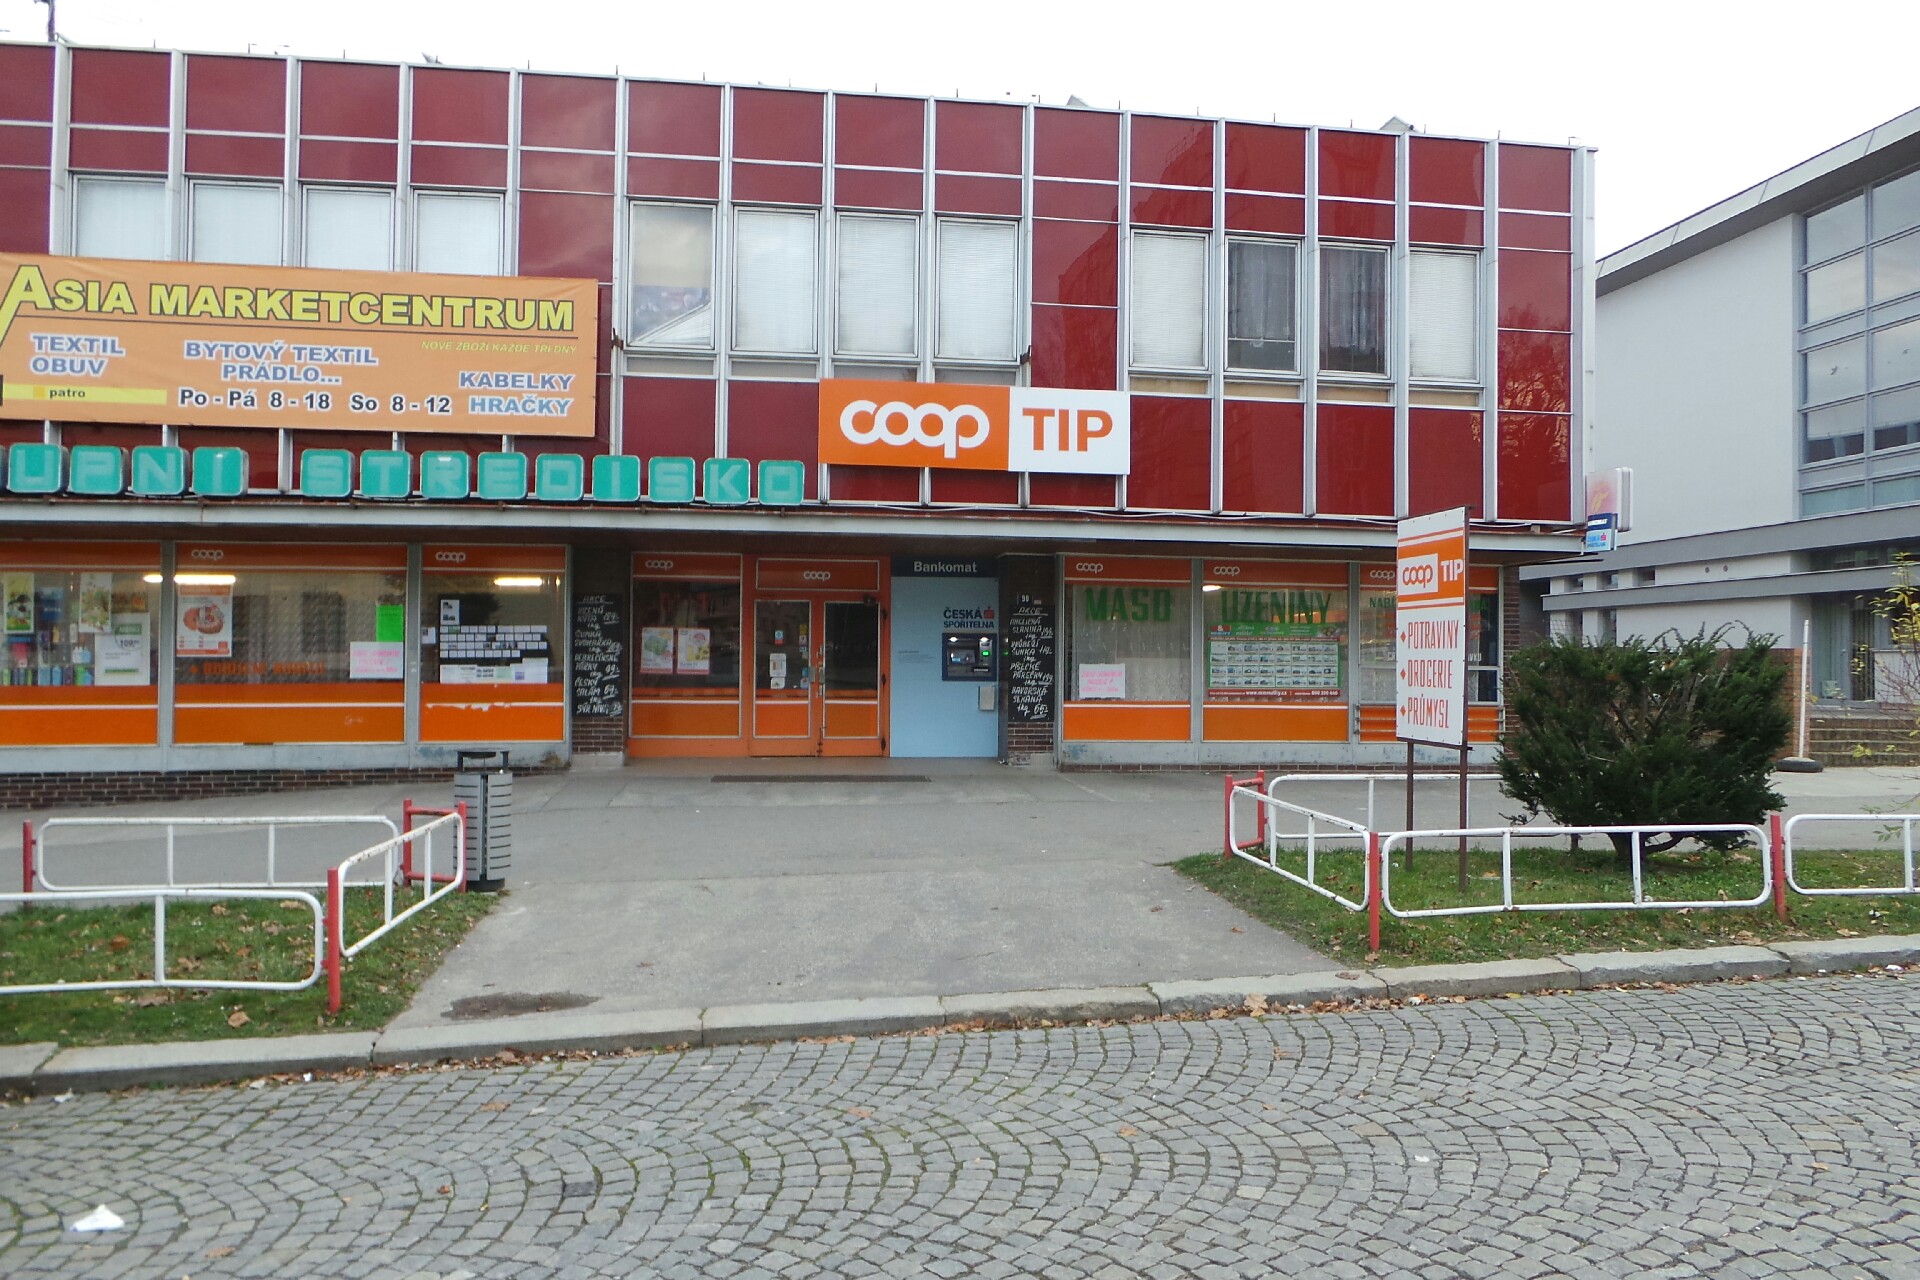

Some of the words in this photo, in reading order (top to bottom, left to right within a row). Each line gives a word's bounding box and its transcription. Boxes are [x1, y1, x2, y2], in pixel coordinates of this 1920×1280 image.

[0, 265, 137, 335] ASIA
[150, 284, 574, 331] MARKETCENTRUM
[31, 333, 125, 356] TEXTIL
[184, 340, 287, 362] BYTOVÝ
[292, 345, 378, 364] TEXTIL
[31, 356, 107, 376] OBUV
[222, 361, 341, 384] PRÁDLO...
[459, 371, 575, 391] KABELKY
[49, 389, 86, 399] patro
[179, 388, 208, 407] Po
[228, 388, 257, 409] Pá
[269, 391, 282, 409] 8
[304, 393, 331, 410] 18
[350, 393, 378, 411] So
[391, 395, 405, 413] 8
[426, 396, 451, 413] 12
[470, 394, 572, 415] HRAČKY
[839, 399, 990, 459] coop
[1022, 407, 1113, 452] TIP
[191, 550, 223, 560] coop
[436, 552, 466, 563] coop
[645, 559, 673, 570] coop
[803, 571, 831, 581] coop
[913, 561, 978, 573] Bankomat
[1076, 562, 1103, 573] coop
[1213, 566, 1240, 577] coop
[1370, 569, 1395, 580] coop
[1402, 564, 1433, 589] coop
[1441, 558, 1464, 582] TIP
[943, 606, 983, 619] ČESKÁ
[1084, 587, 1172, 622] MASO
[1221, 590, 1332, 625] UZENINY
[1407, 619, 1460, 650] POTRAVINY
[1407, 659, 1453, 689] DROGERIE
